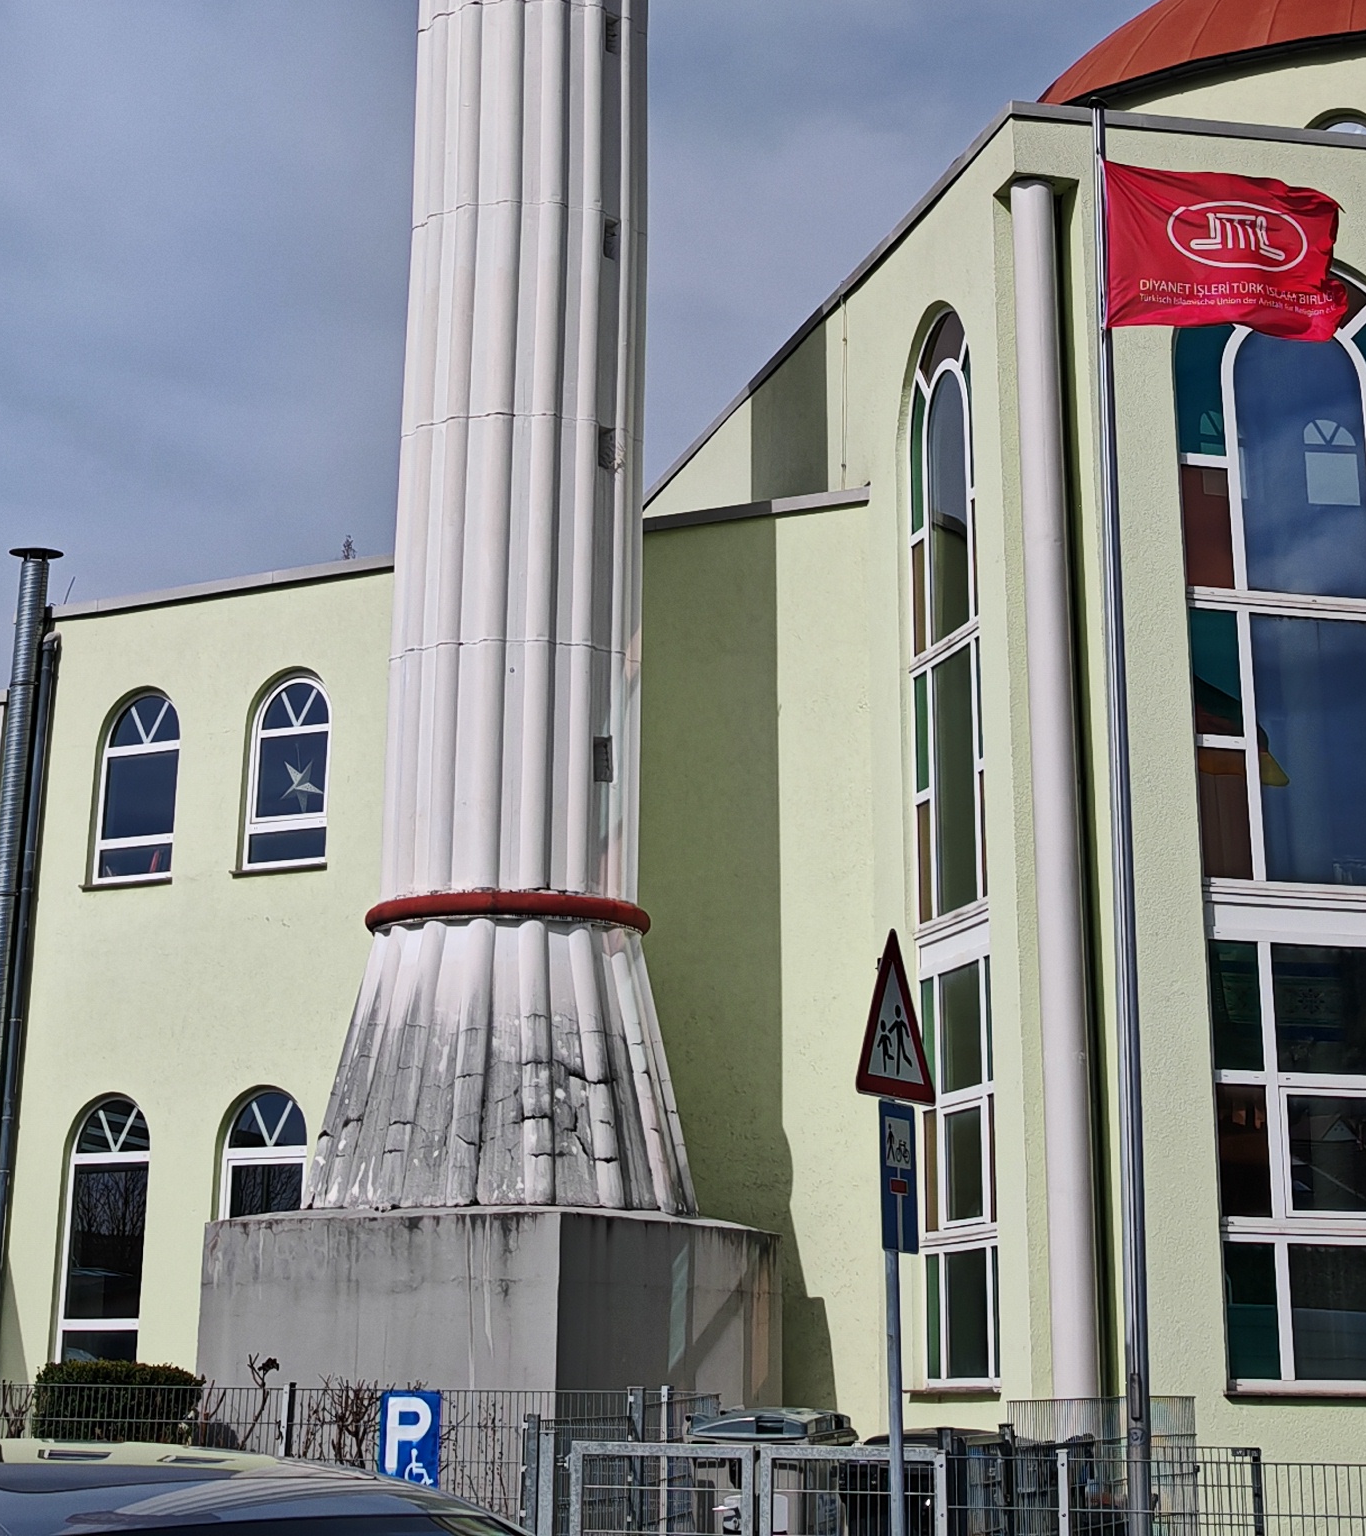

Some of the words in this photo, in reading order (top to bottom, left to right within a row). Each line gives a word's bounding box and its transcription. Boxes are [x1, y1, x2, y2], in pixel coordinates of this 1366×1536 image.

[1139, 278, 1191, 295] DİYANET
[1193, 281, 1229, 298] İŞLERİ
[1231, 281, 1264, 294] TÜRK
[1139, 293, 1172, 304] Türkisch
[1173, 297, 1215, 305] Islamische
[1216, 297, 1241, 305] Union
[385, 1396, 432, 1475] P
